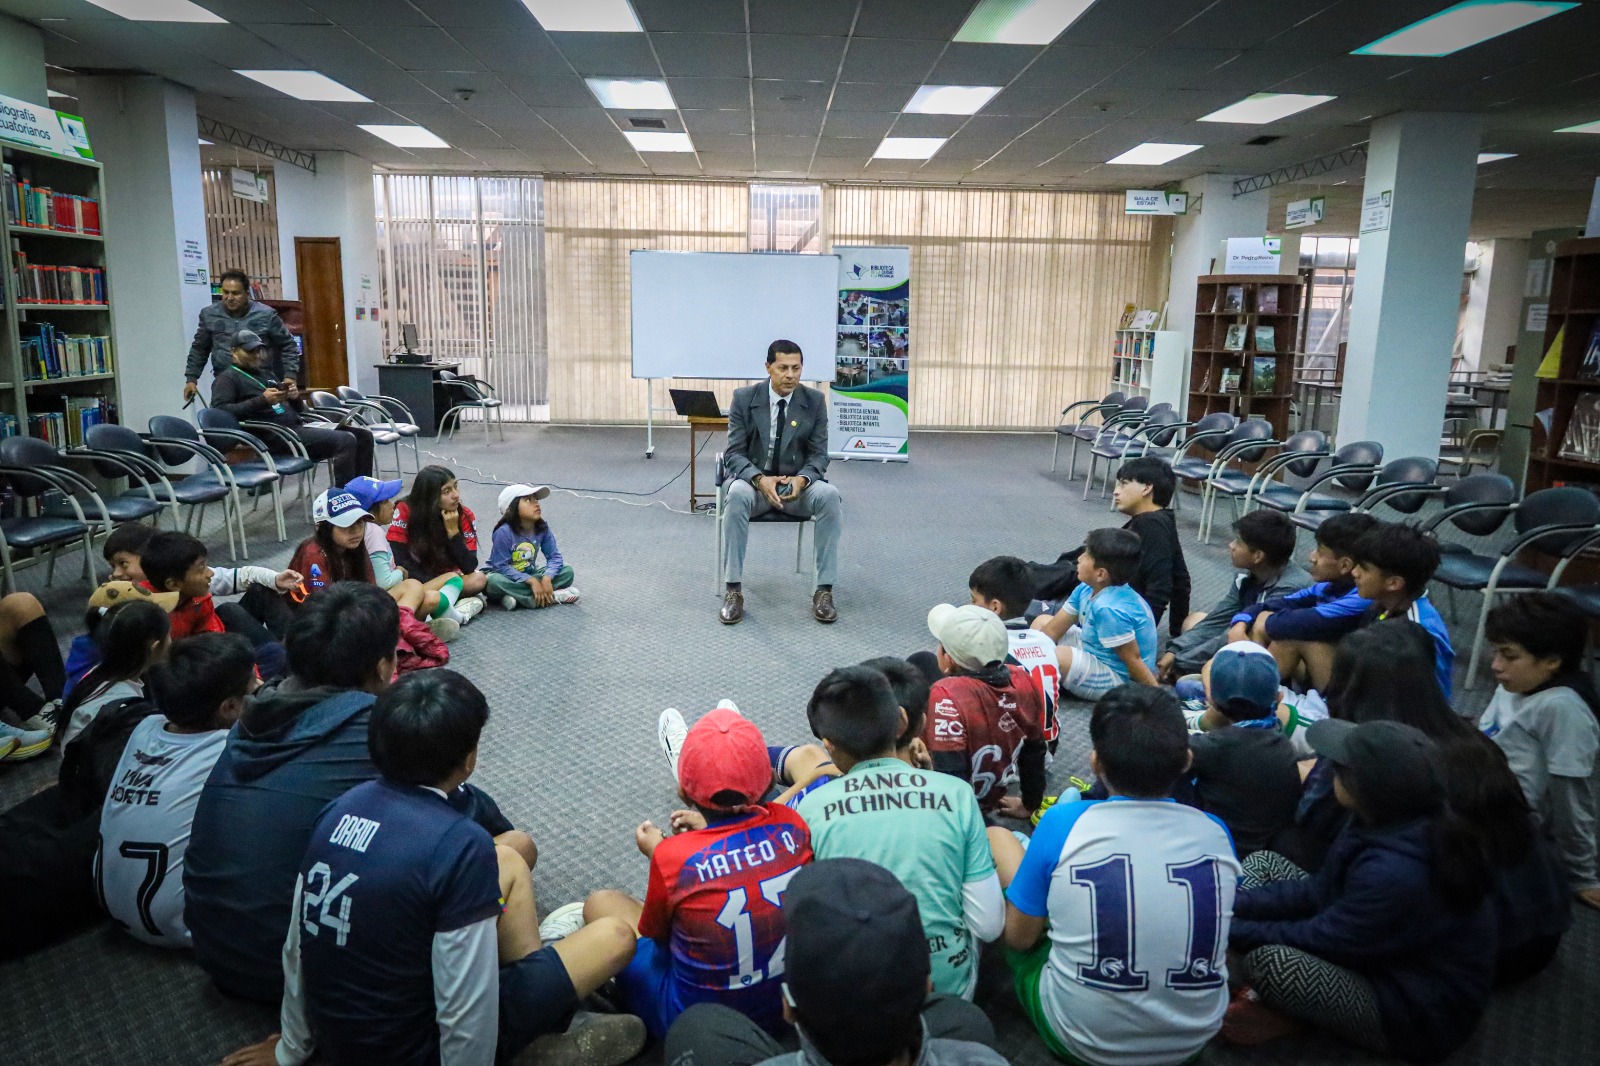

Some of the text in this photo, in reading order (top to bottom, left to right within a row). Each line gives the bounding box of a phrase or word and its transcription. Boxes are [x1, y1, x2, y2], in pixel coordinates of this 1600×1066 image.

[844, 772, 927, 793] BANCO
[823, 790, 953, 821] PICHINCHA
[329, 814, 380, 853] DARIO
[696, 839, 776, 883] MATEO
[119, 840, 169, 936] 7
[303, 861, 360, 947] 24
[1070, 854, 1224, 992] 11
